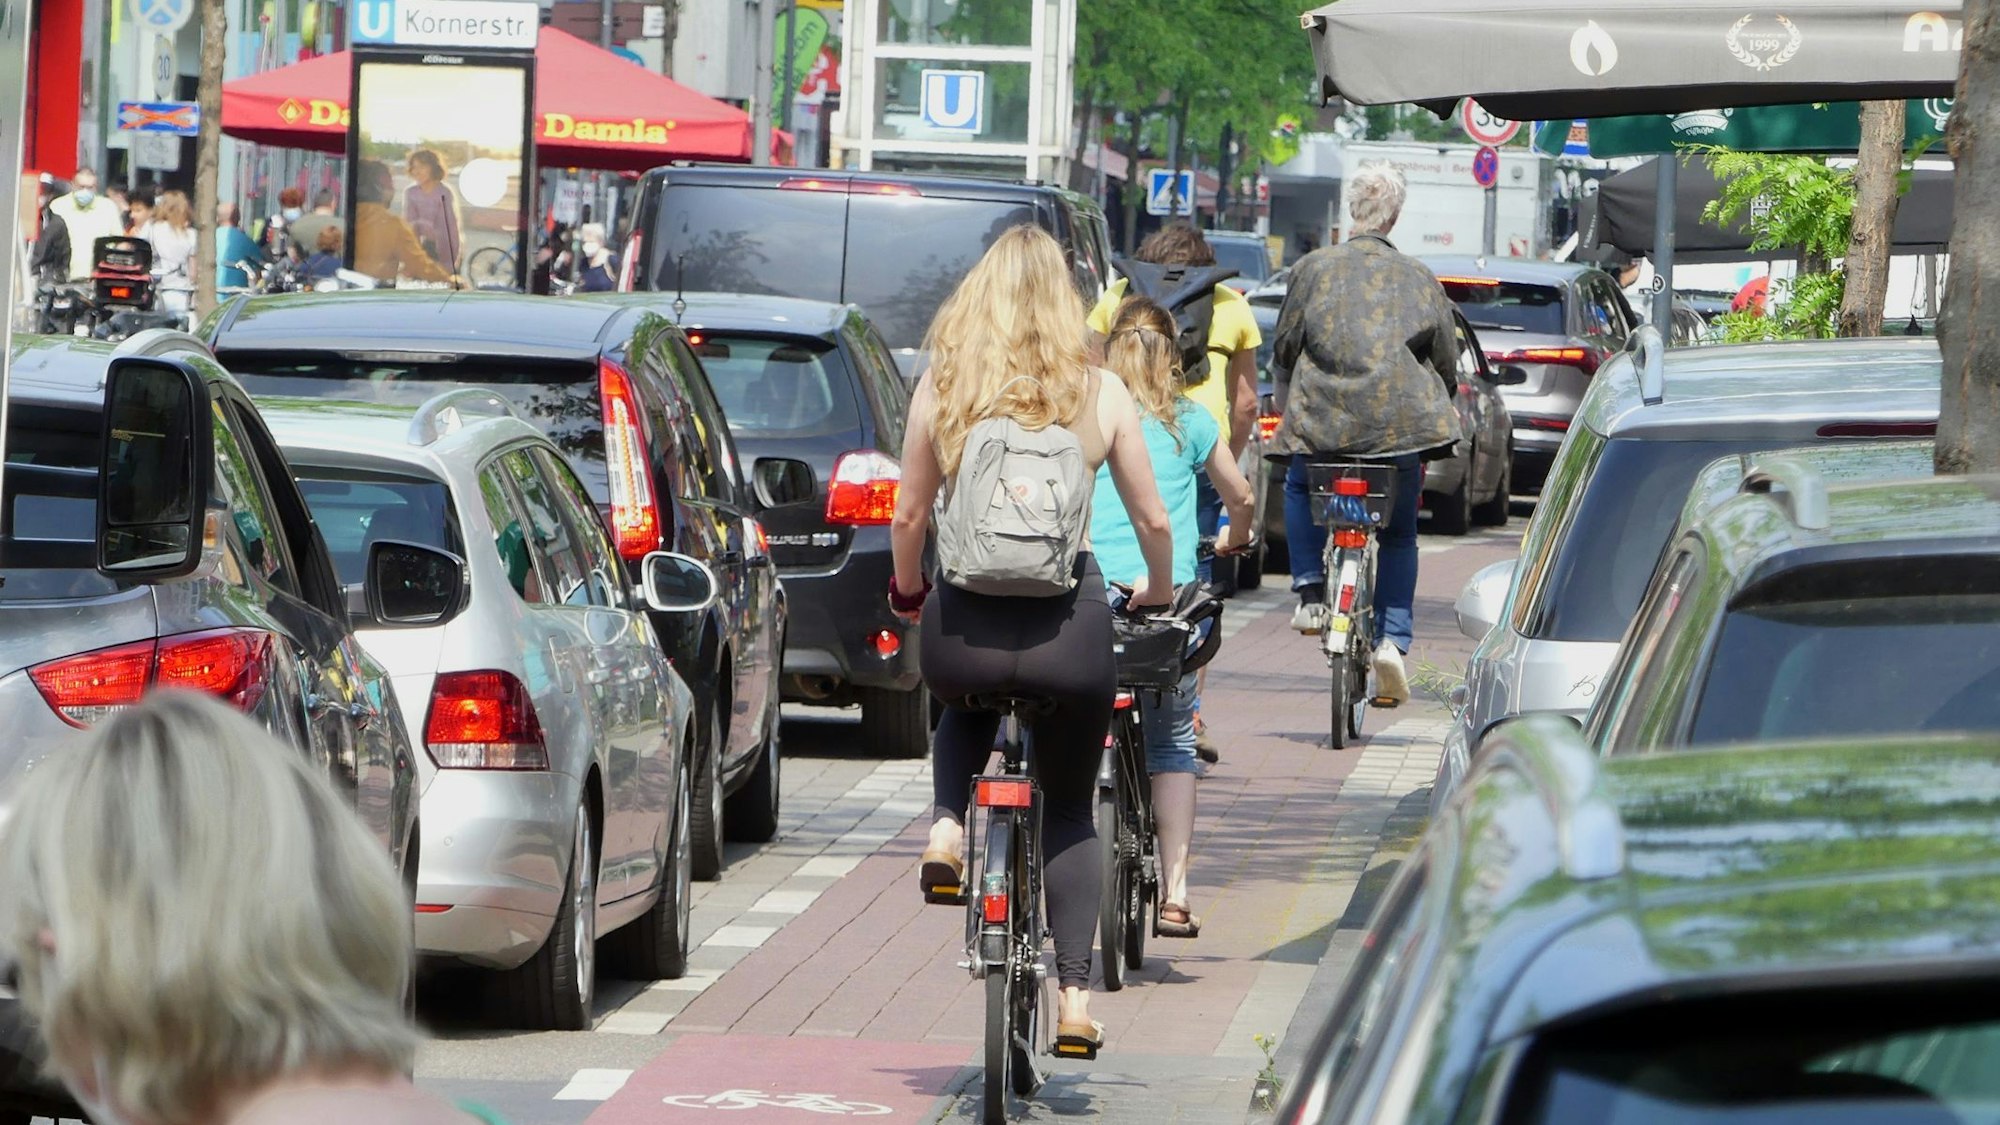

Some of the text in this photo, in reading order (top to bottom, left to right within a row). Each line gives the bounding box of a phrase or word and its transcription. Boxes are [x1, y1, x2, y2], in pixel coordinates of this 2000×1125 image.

[359, 1, 390, 39] U
[1749, 39, 1780, 51] 1999
[157, 55, 171, 81] 30
[927, 75, 977, 127] U
